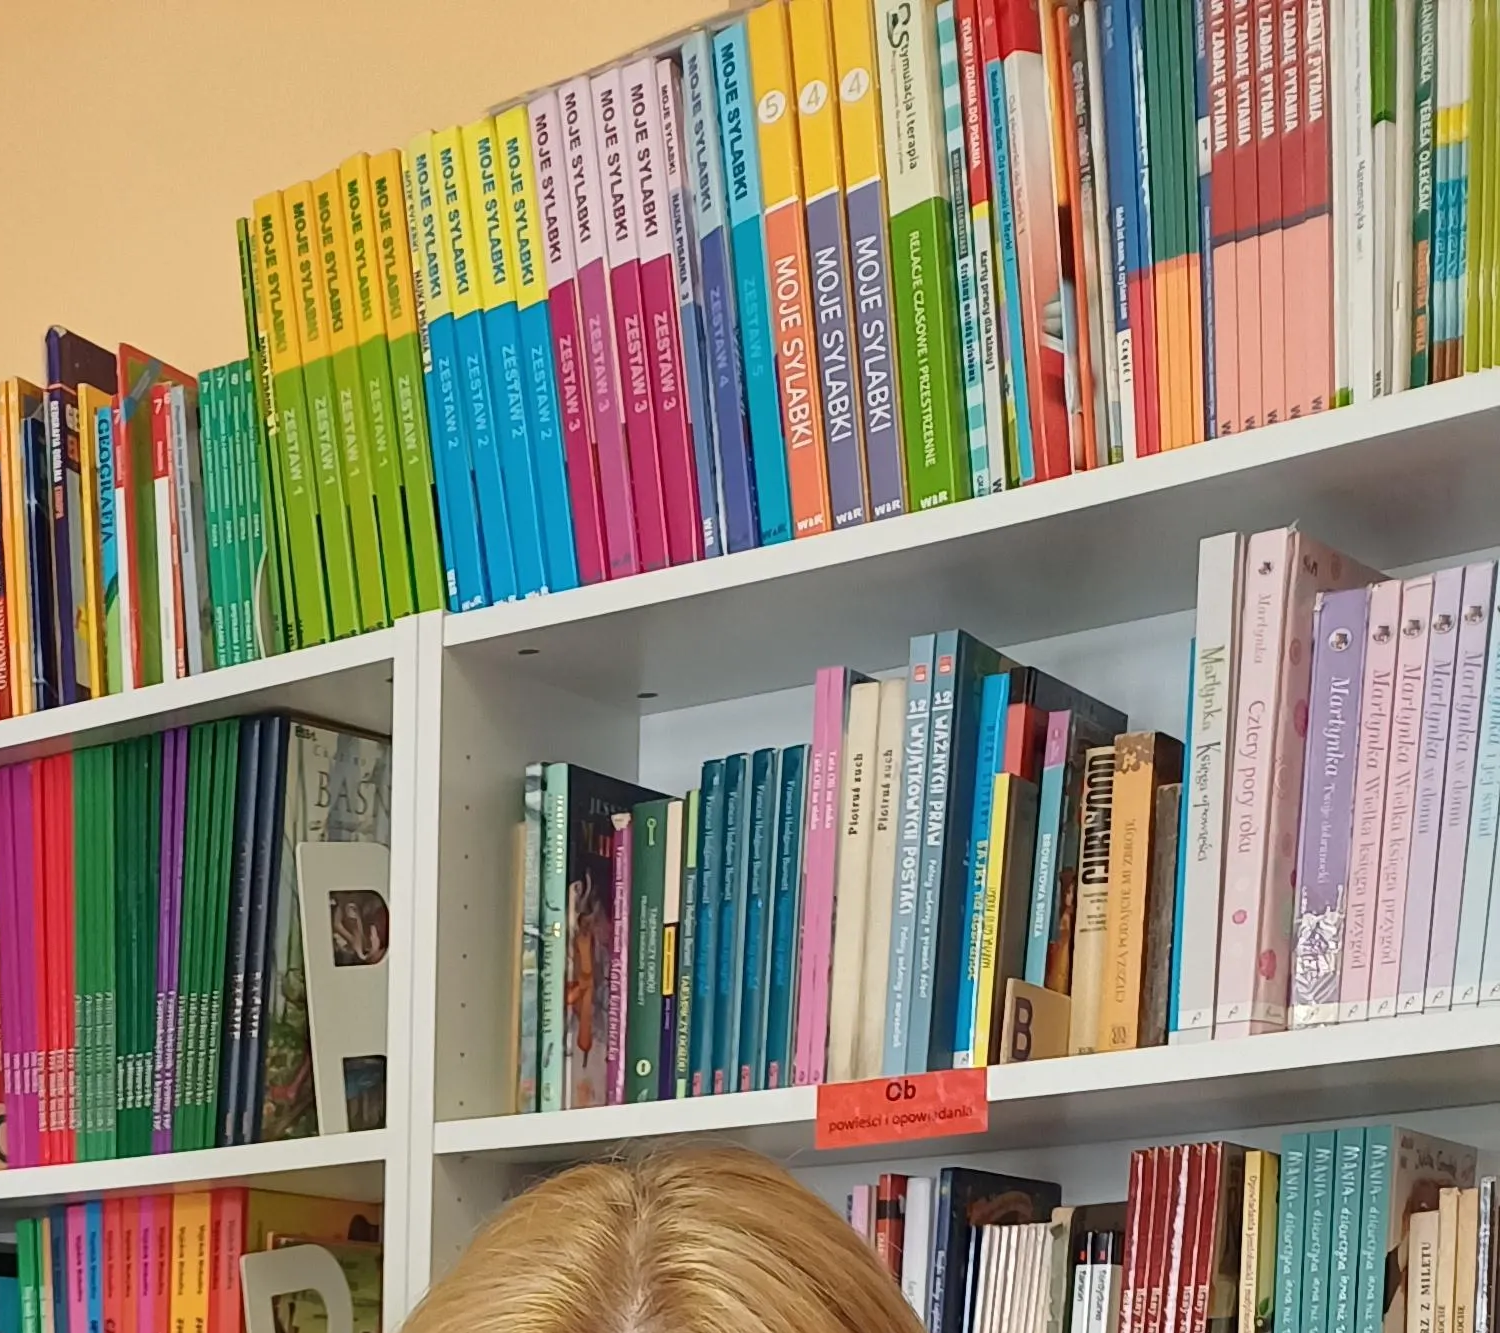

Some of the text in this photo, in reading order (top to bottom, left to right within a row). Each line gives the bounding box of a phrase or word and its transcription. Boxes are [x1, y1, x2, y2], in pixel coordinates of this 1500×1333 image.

[766, 95, 779, 118] 5
[807, 83, 821, 106] 4
[848, 72, 862, 94] 4
[898, 31, 915, 111] Stymulacja
[630, 83, 659, 238] MOJE SYLABKI
[688, 53, 712, 213] MOJE SYLABKI
[721, 42, 748, 201] MOJE SYLABKI
[906, 120, 920, 170] terapia
[1417, 99, 1432, 213] TERESA OLEKSAK
[909, 231, 923, 289] RELACJE
[979, 251, 990, 281] Karty
[979, 284, 992, 314] pracy
[775, 255, 813, 450] MOJE SYLABKI
[815, 246, 852, 442] MOJE SYLABKI
[855, 235, 892, 433] MOJE SYLABKI
[913, 290, 928, 355] CZASOWE
[983, 317, 994, 332] dla
[983, 336, 996, 363] klasy
[439, 356, 457, 432] ZESTAW
[559, 334, 579, 414] ZESTAW
[919, 365, 936, 467] PRZESTRZENNE
[97, 419, 114, 544] GEOGRAFIA
[284, 408, 303, 481] ZESTAW
[1236, 593, 1273, 854] Martynka Cztery pory roku
[1418, 658, 1452, 836] Martynka w domu
[898, 724, 924, 915] WYJĄTKOWYCH POSTACI
[926, 715, 949, 847] WAŻNYCH PRAW
[1316, 676, 1351, 885] Martynka Twoje dobranocki
[1348, 669, 1392, 970] Martynka Wielka księga przygód
[1377, 663, 1423, 967] Martynka Wielka księga przygód
[1033, 833, 1052, 938] BROKATOWA BURZA
[1013, 995, 1034, 1061] B
[829, 1115, 881, 1133] powieści
[1419, 1241, 1432, 1296] MILETU
